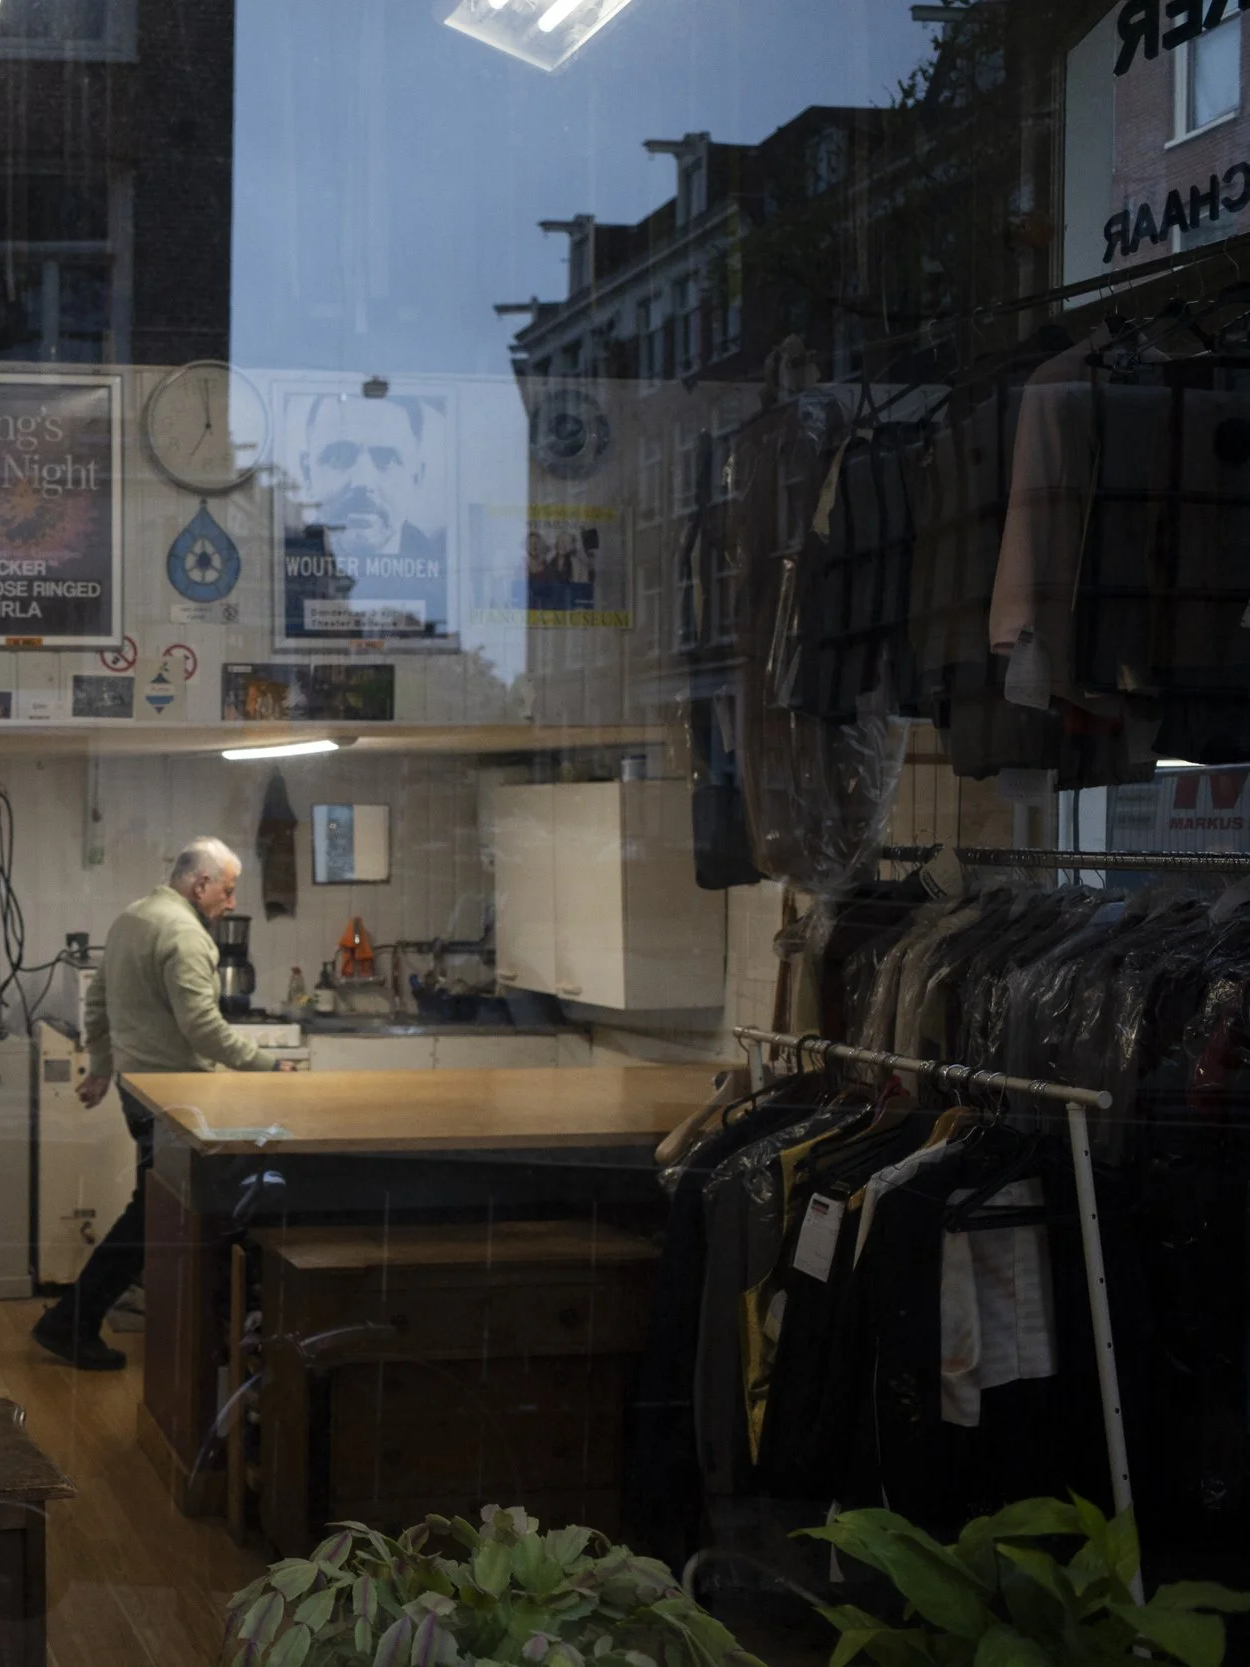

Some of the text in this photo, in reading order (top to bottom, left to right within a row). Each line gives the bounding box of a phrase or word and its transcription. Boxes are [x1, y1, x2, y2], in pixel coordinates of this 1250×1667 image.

[1, 453, 99, 499] Night
[286, 556, 439, 578] WOUTER MONDEN
[33, 581, 101, 597] RINGED
[1169, 816, 1244, 831] MARKUS
